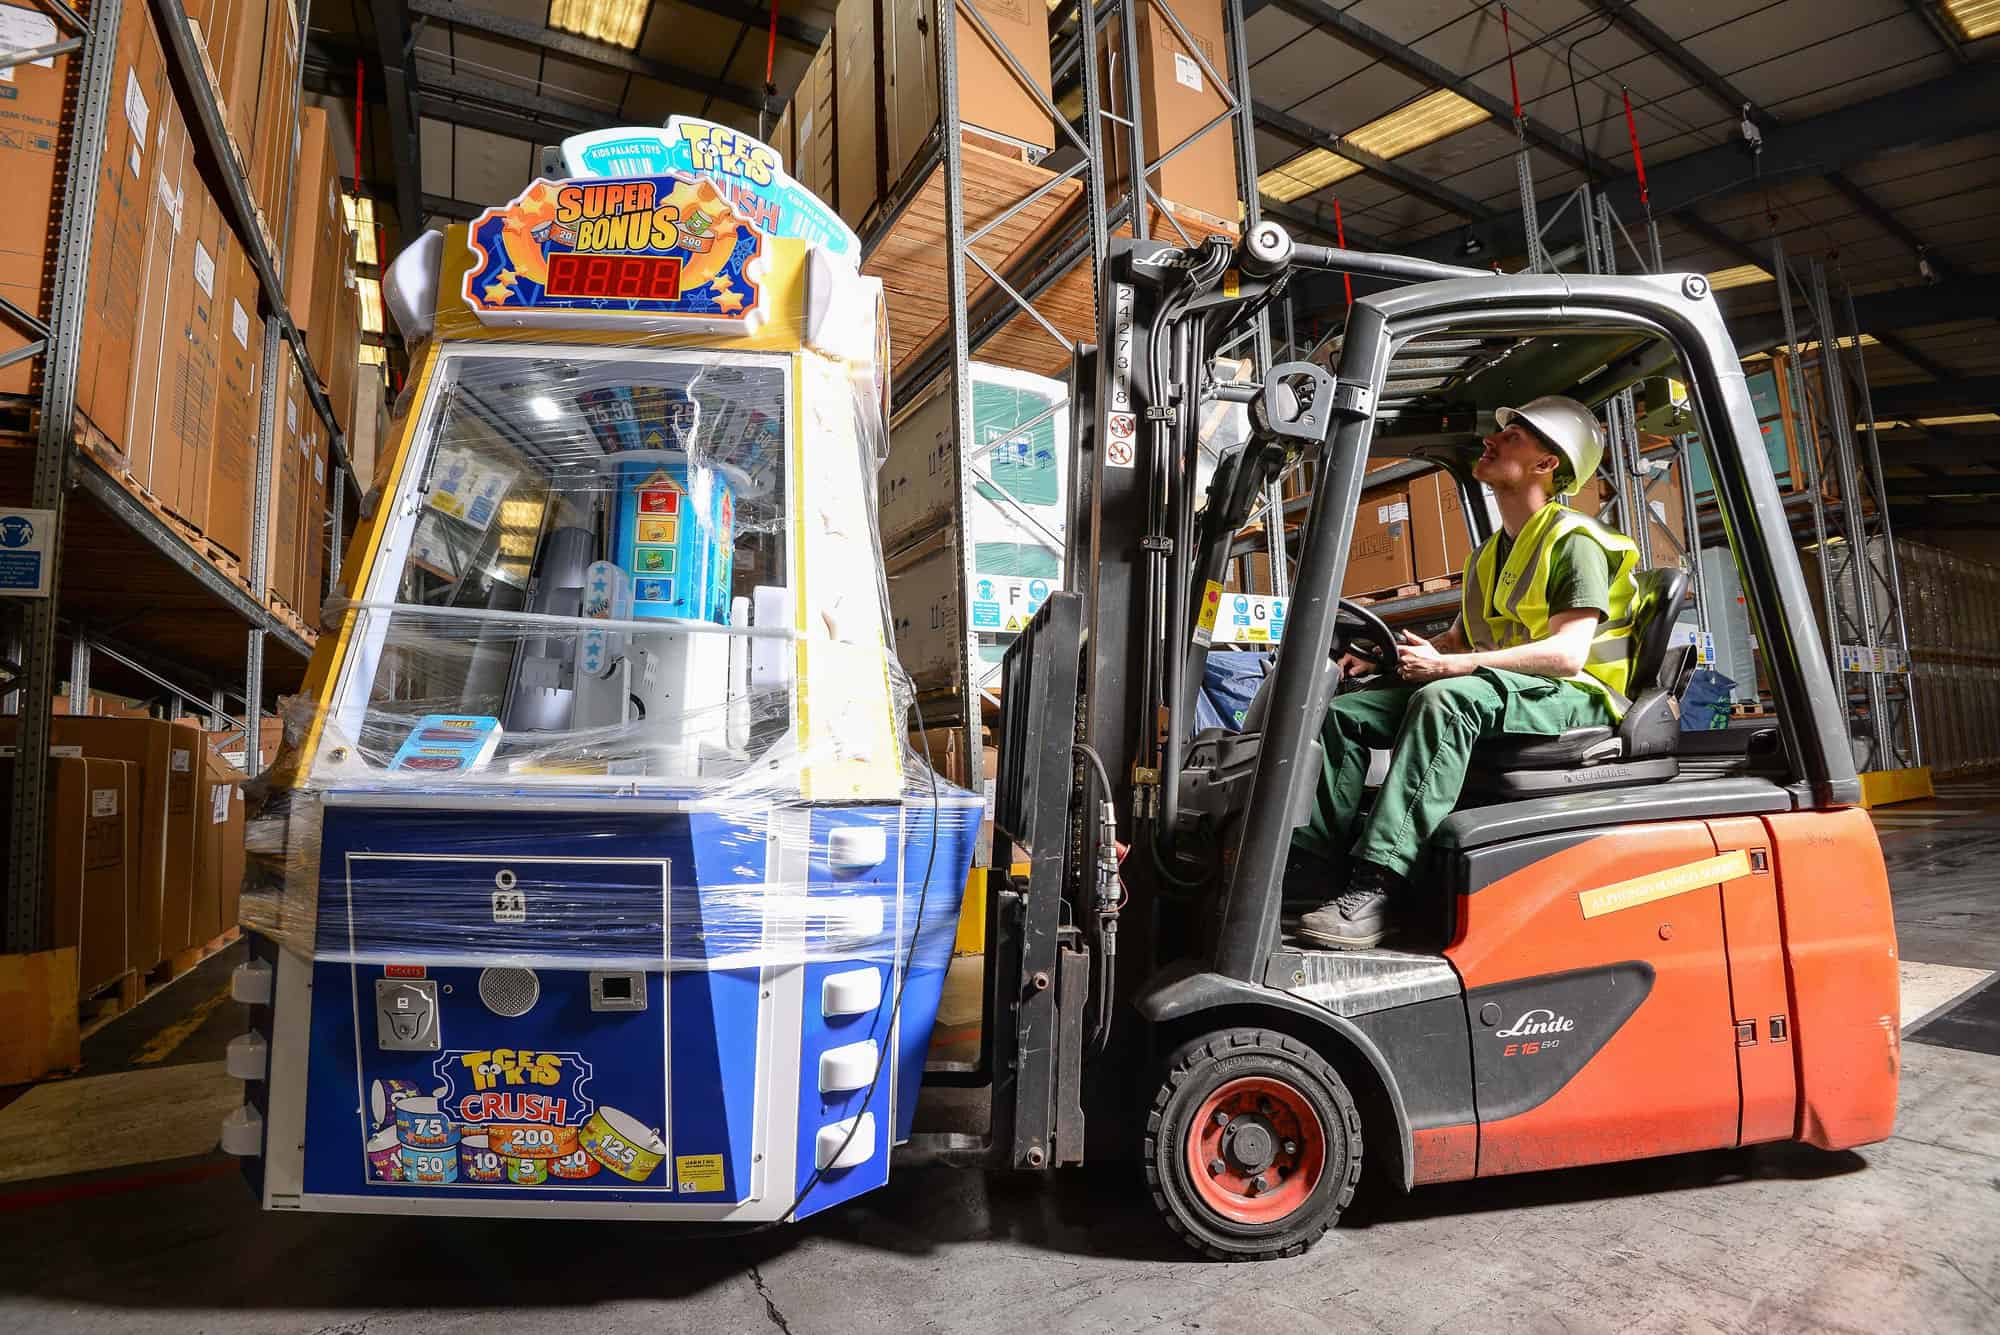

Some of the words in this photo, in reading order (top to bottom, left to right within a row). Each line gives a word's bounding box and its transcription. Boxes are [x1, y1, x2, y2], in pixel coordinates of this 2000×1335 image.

[609, 144, 640, 156] PALACE
[556, 182, 656, 223] SUPER
[575, 204, 680, 252] BONUS
[682, 236, 702, 247] 200
[1115, 287, 1132, 405] 2427318
[1008, 586, 1022, 606] F
[1253, 603, 1266, 621] G
[495, 894, 524, 912] £1
[1495, 1009, 1575, 1038] Linde
[1503, 1043, 1519, 1057] E
[1521, 1041, 1540, 1055] 16
[459, 1092, 568, 1125] CRUSH
[414, 1118, 442, 1136] 75
[511, 1129, 554, 1146] 200
[600, 1134, 638, 1165] 125
[416, 1156, 444, 1173] 50
[474, 1152, 498, 1169] 10
[519, 1158, 535, 1174] 5
